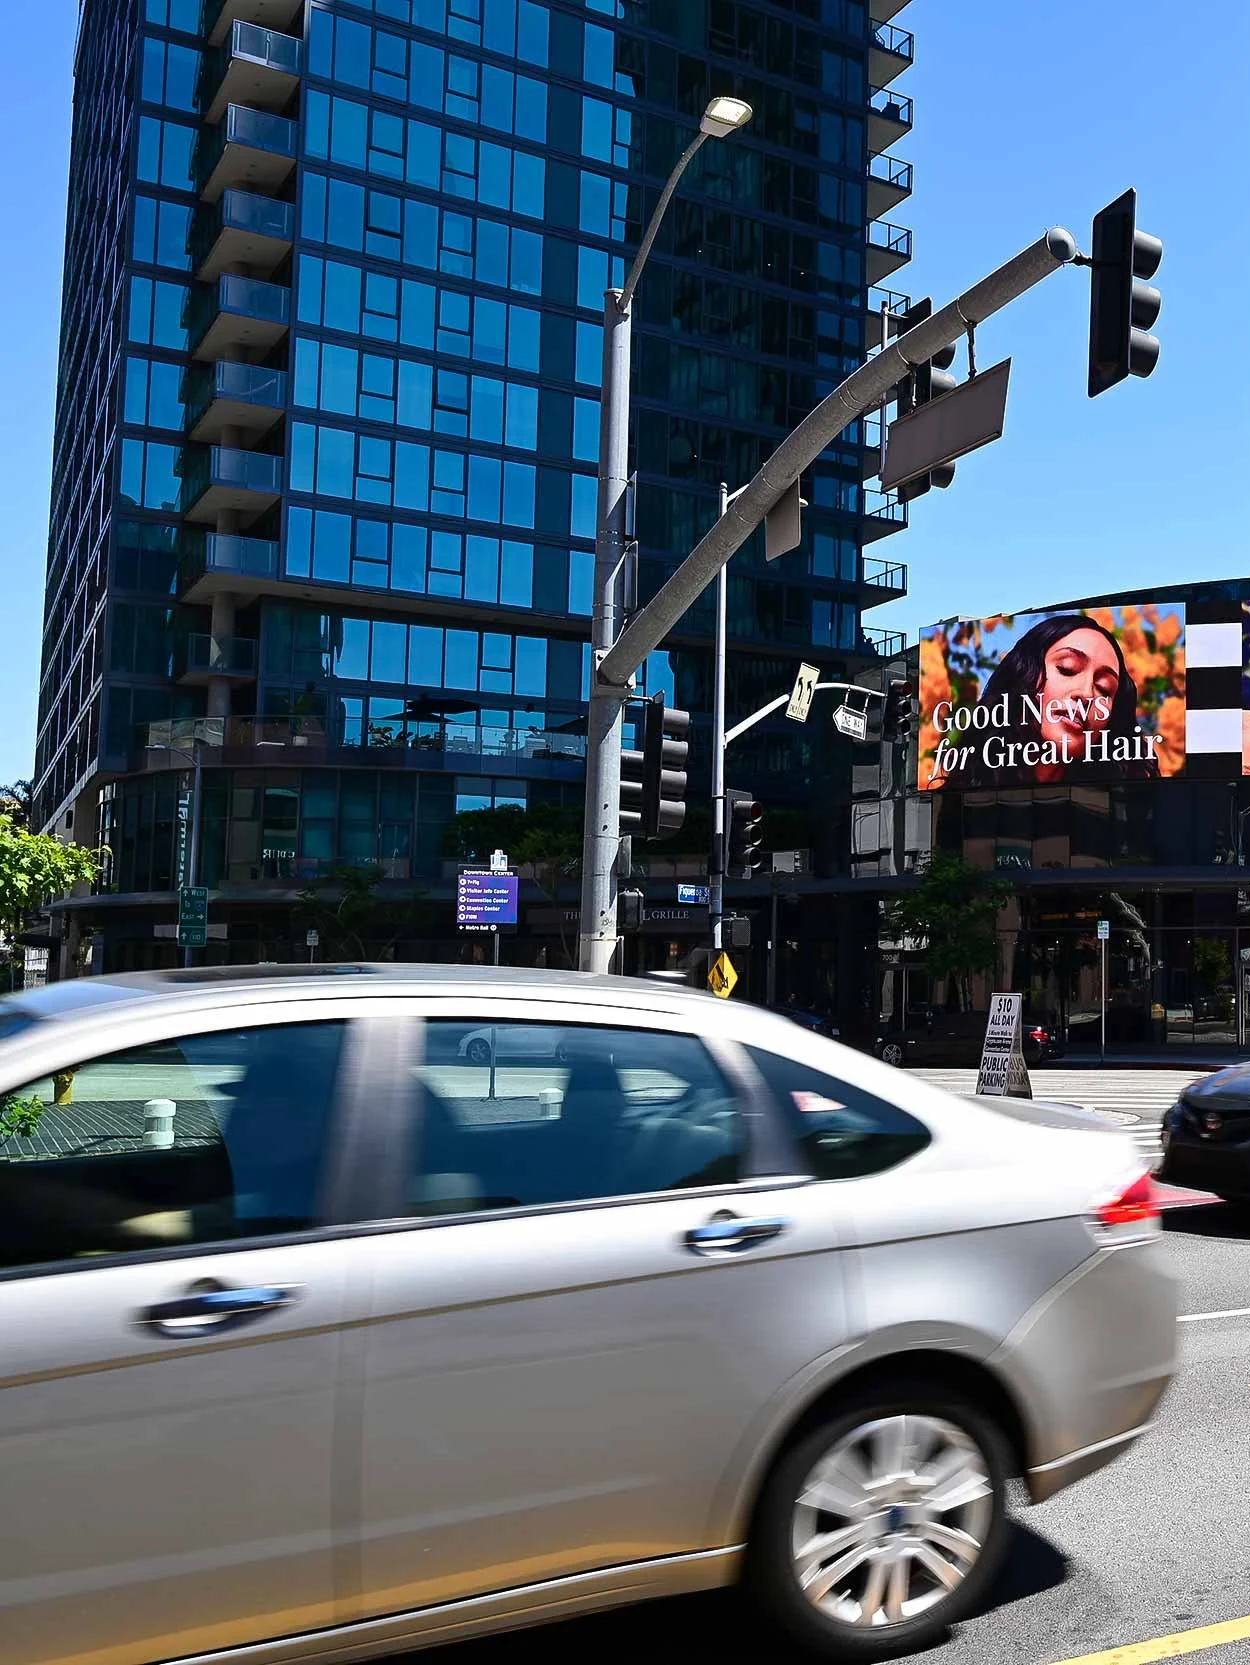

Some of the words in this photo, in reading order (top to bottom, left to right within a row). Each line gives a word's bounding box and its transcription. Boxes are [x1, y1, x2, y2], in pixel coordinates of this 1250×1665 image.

[932, 692, 1011, 733] Good
[1020, 692, 1111, 726] News
[928, 738, 975, 780] for
[982, 735, 1073, 769] Great
[1082, 726, 1163, 763] Hair
[563, 911, 581, 921] TH
[651, 910, 689, 921] GRILLE
[997, 998, 1013, 1013] $10
[990, 1014, 1001, 1026] ALL
[1001, 1014, 1016, 1026] DAY
[981, 1056, 1009, 1072] PUBLIC
[980, 1071, 1006, 1088] PARKING
